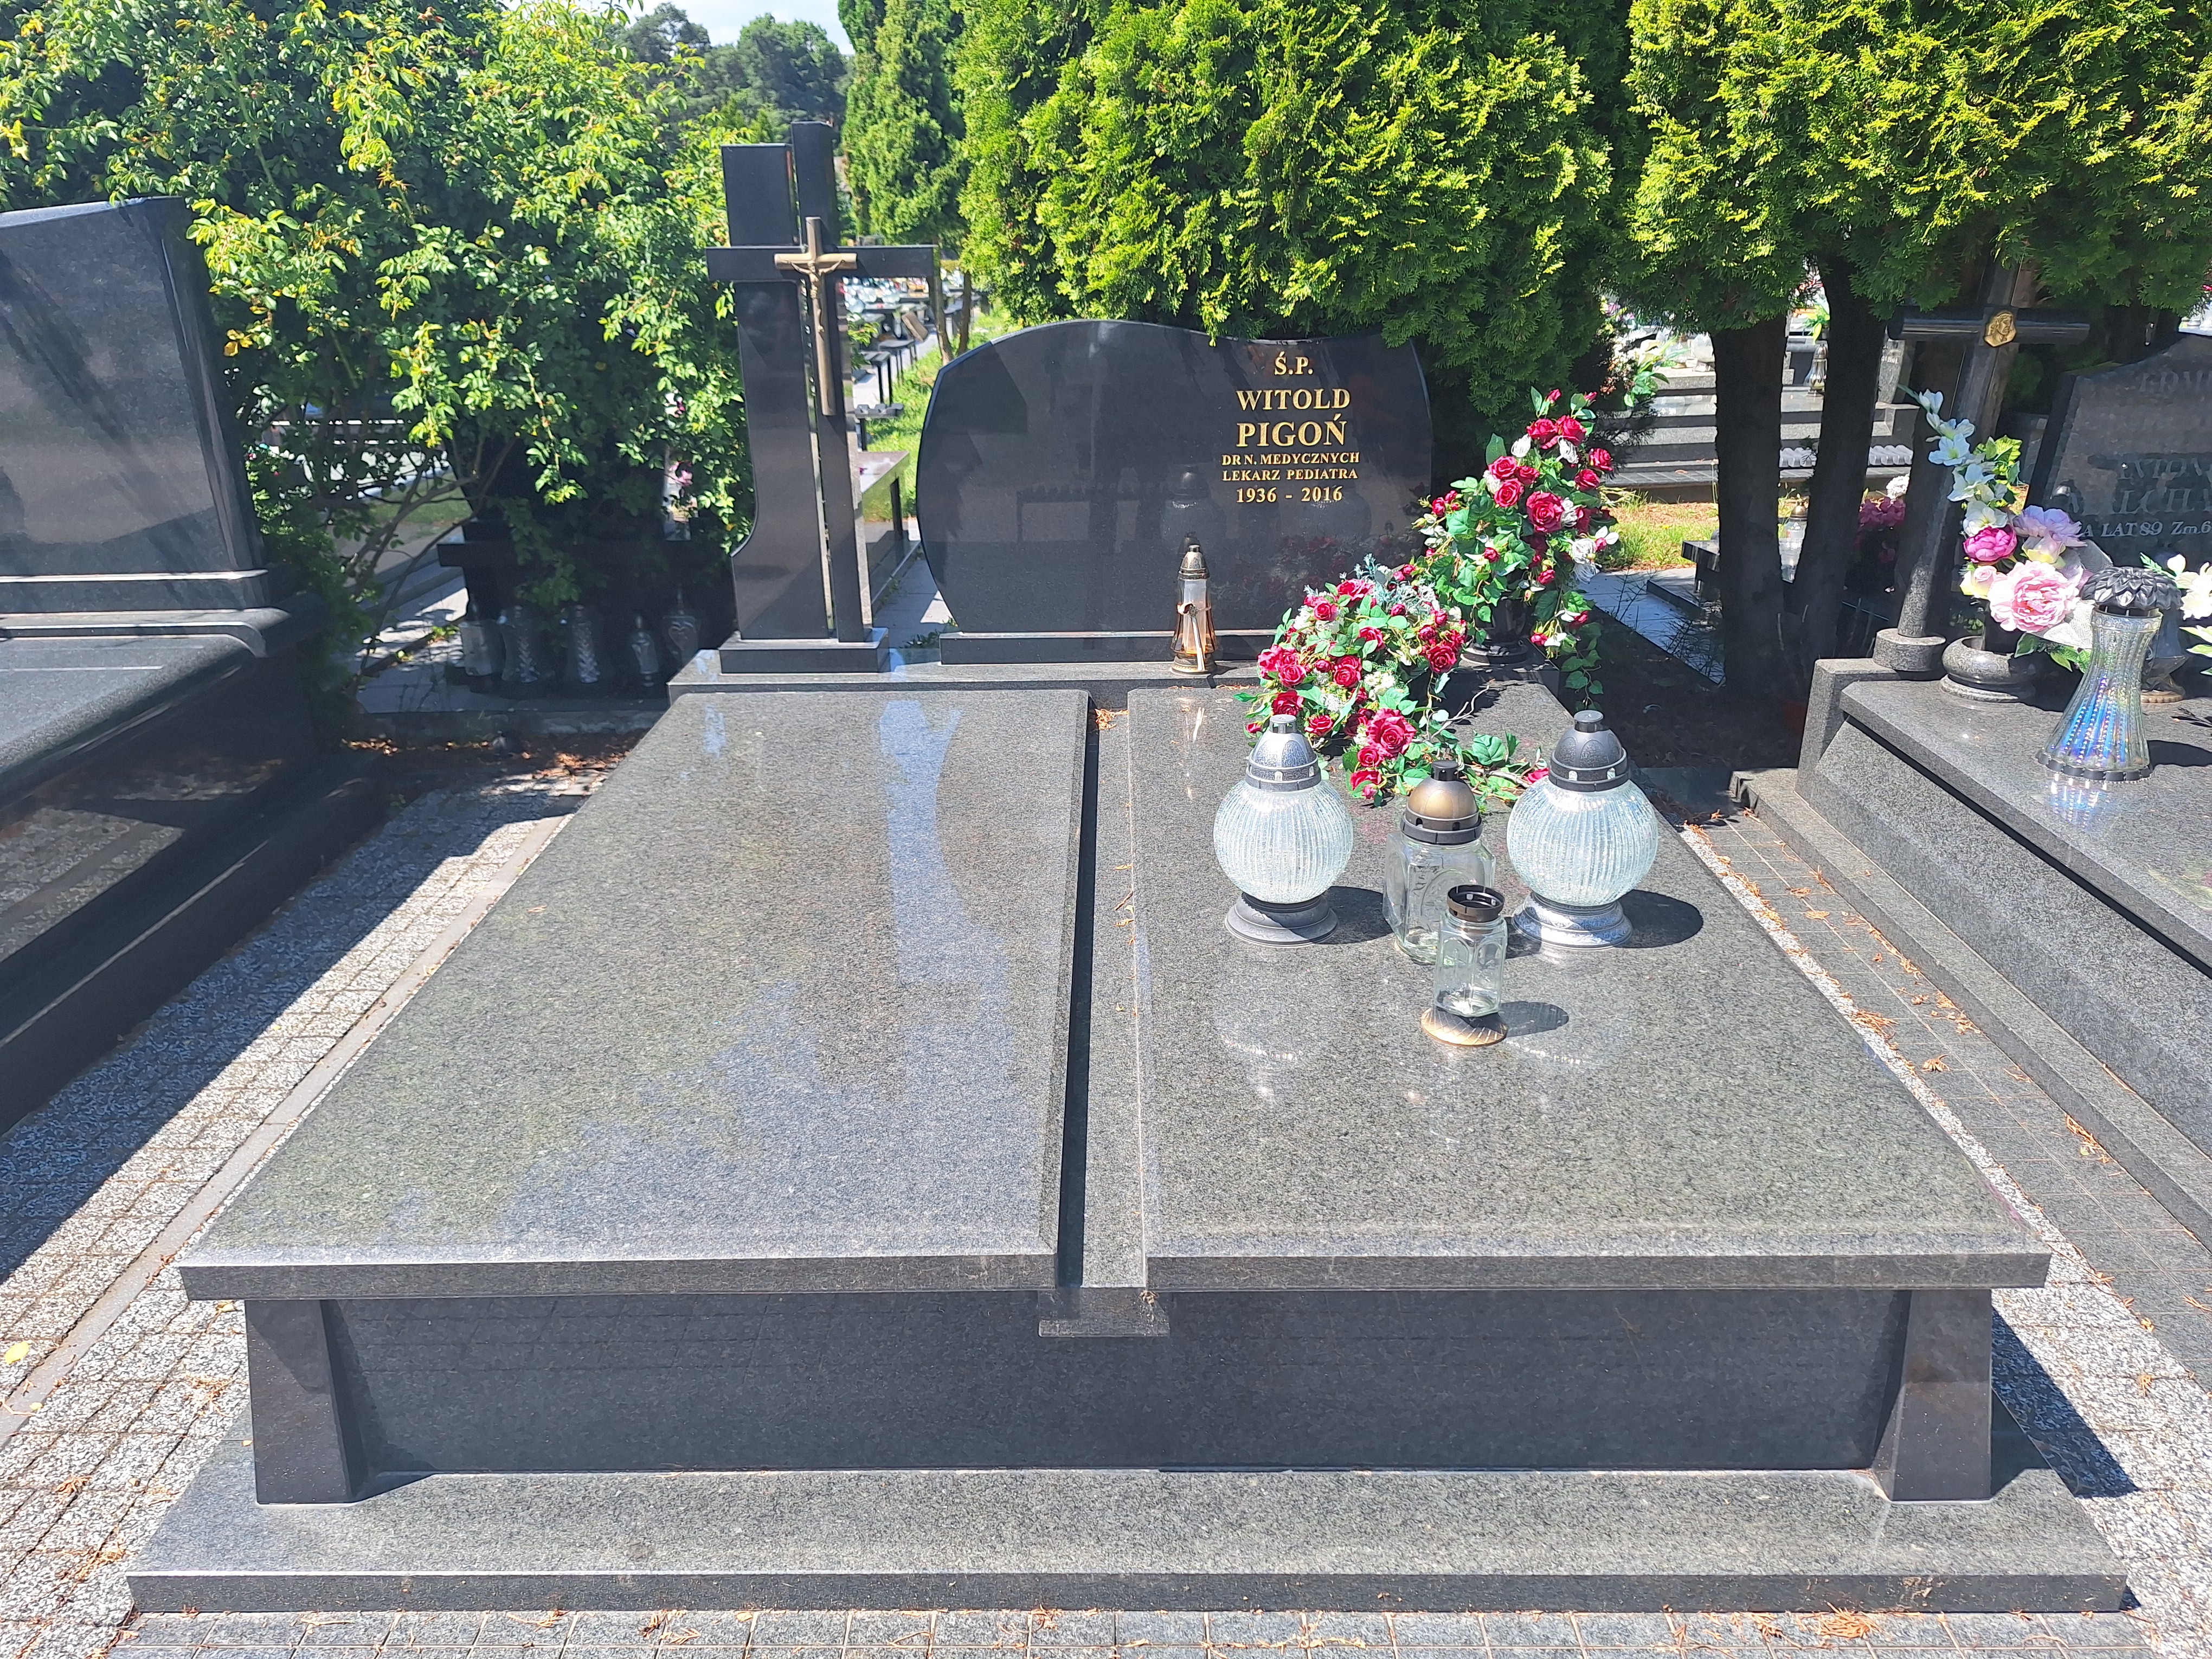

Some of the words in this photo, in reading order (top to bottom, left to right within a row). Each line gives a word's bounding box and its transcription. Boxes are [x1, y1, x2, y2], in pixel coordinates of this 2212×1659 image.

[1274, 351, 1314, 375] Ś.P.
[1236, 388, 1351, 410] WITOLD
[1236, 413, 1347, 447] PIGOŃ
[1221, 454, 1241, 466] DR
[1244, 454, 1258, 465] N.
[1261, 452, 1360, 465] MEDYCZNYCH
[1222, 470, 1280, 481] LEKARZ
[1286, 468, 1358, 480] PEDIATRA
[1236, 487, 1277, 503] 1936
[1301, 486, 1343, 501] 2016
